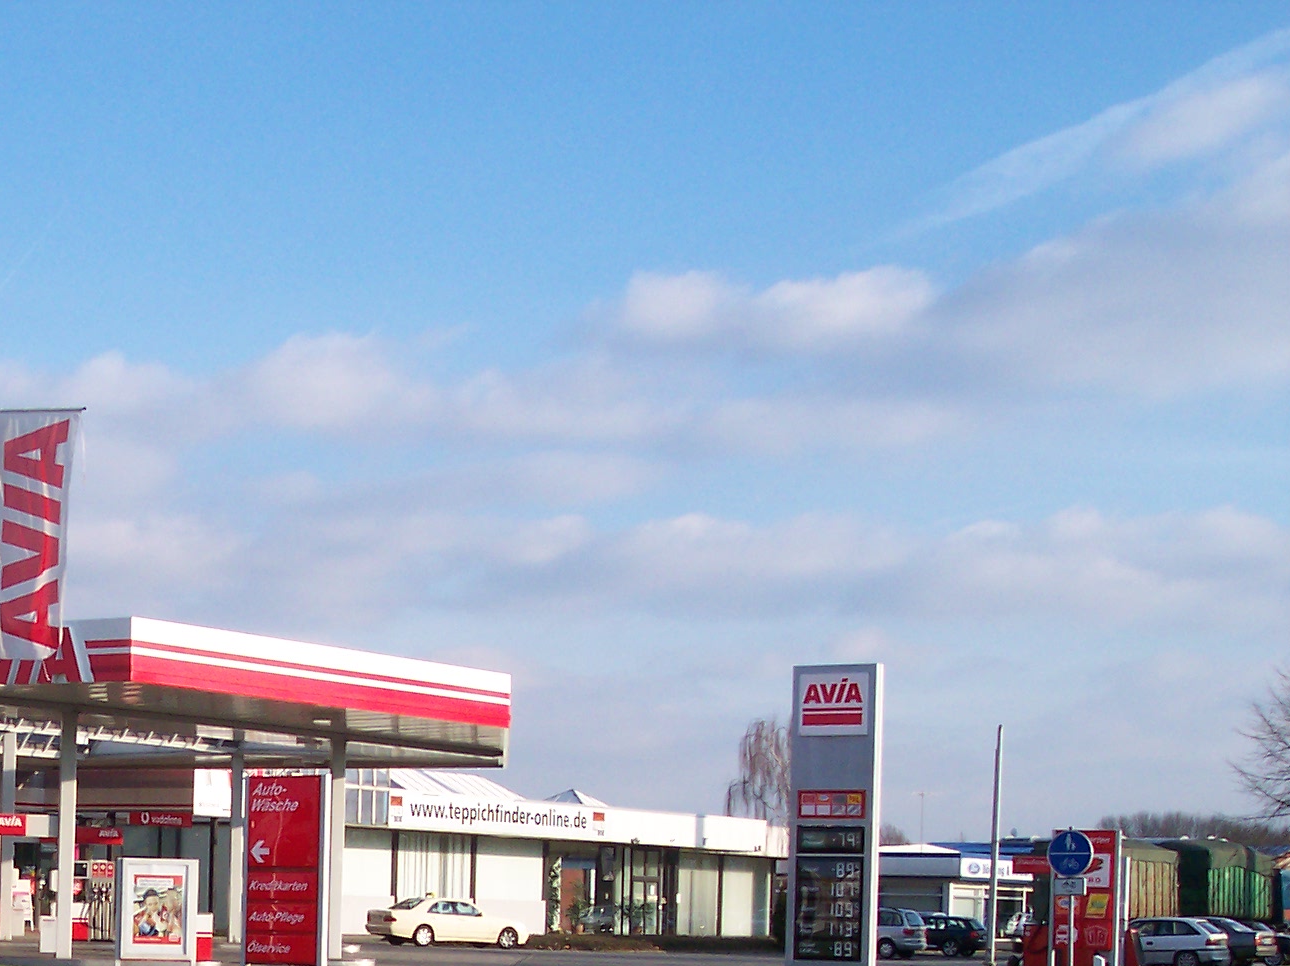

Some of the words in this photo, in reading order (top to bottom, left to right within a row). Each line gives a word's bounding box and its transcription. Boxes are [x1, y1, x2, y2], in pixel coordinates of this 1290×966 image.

[803, 677, 863, 705] AVIA
[252, 782, 287, 796] Auto-
[410, 802, 587, 829] www.teppichfinder-online.de
